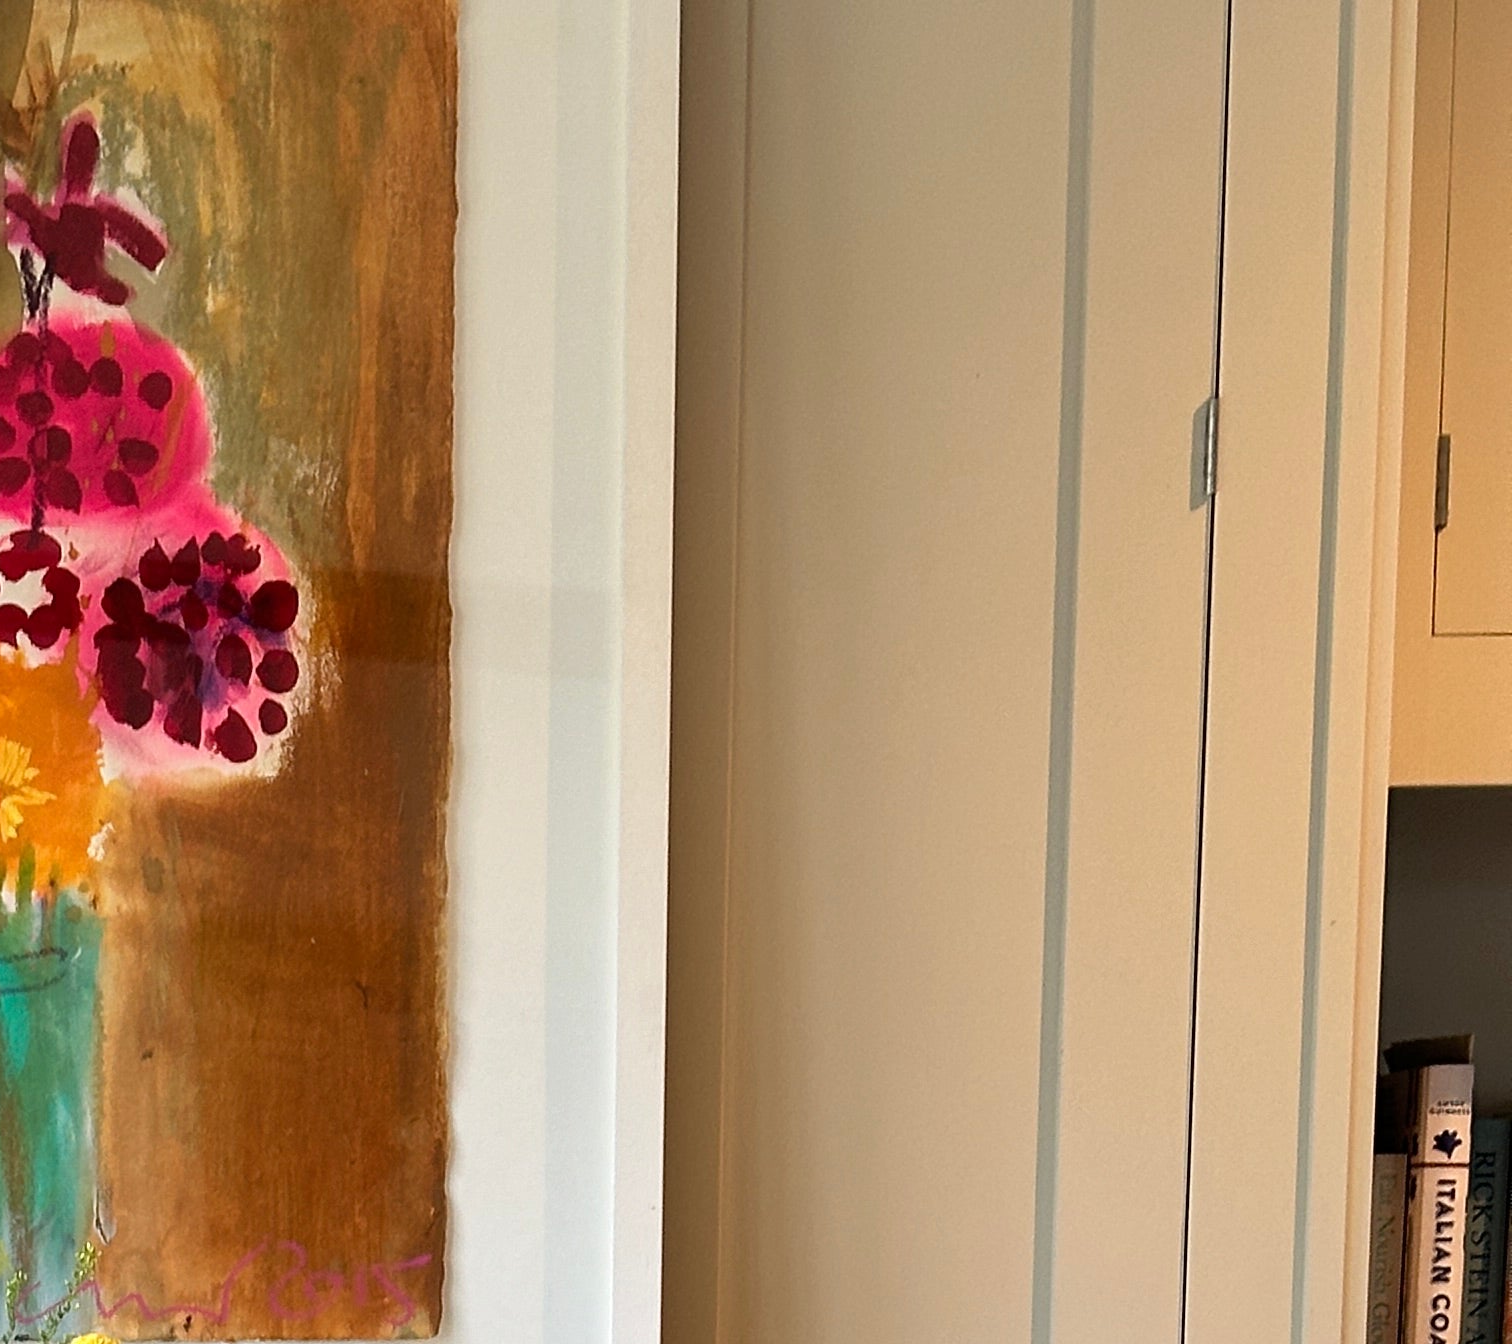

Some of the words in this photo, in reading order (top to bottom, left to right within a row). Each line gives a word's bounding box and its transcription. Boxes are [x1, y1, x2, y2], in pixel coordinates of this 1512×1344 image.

[1432, 1178, 1457, 1284] ITALIAN
[1471, 1151, 1496, 1226] RICK
[1466, 1231, 1492, 1318] STEIN
